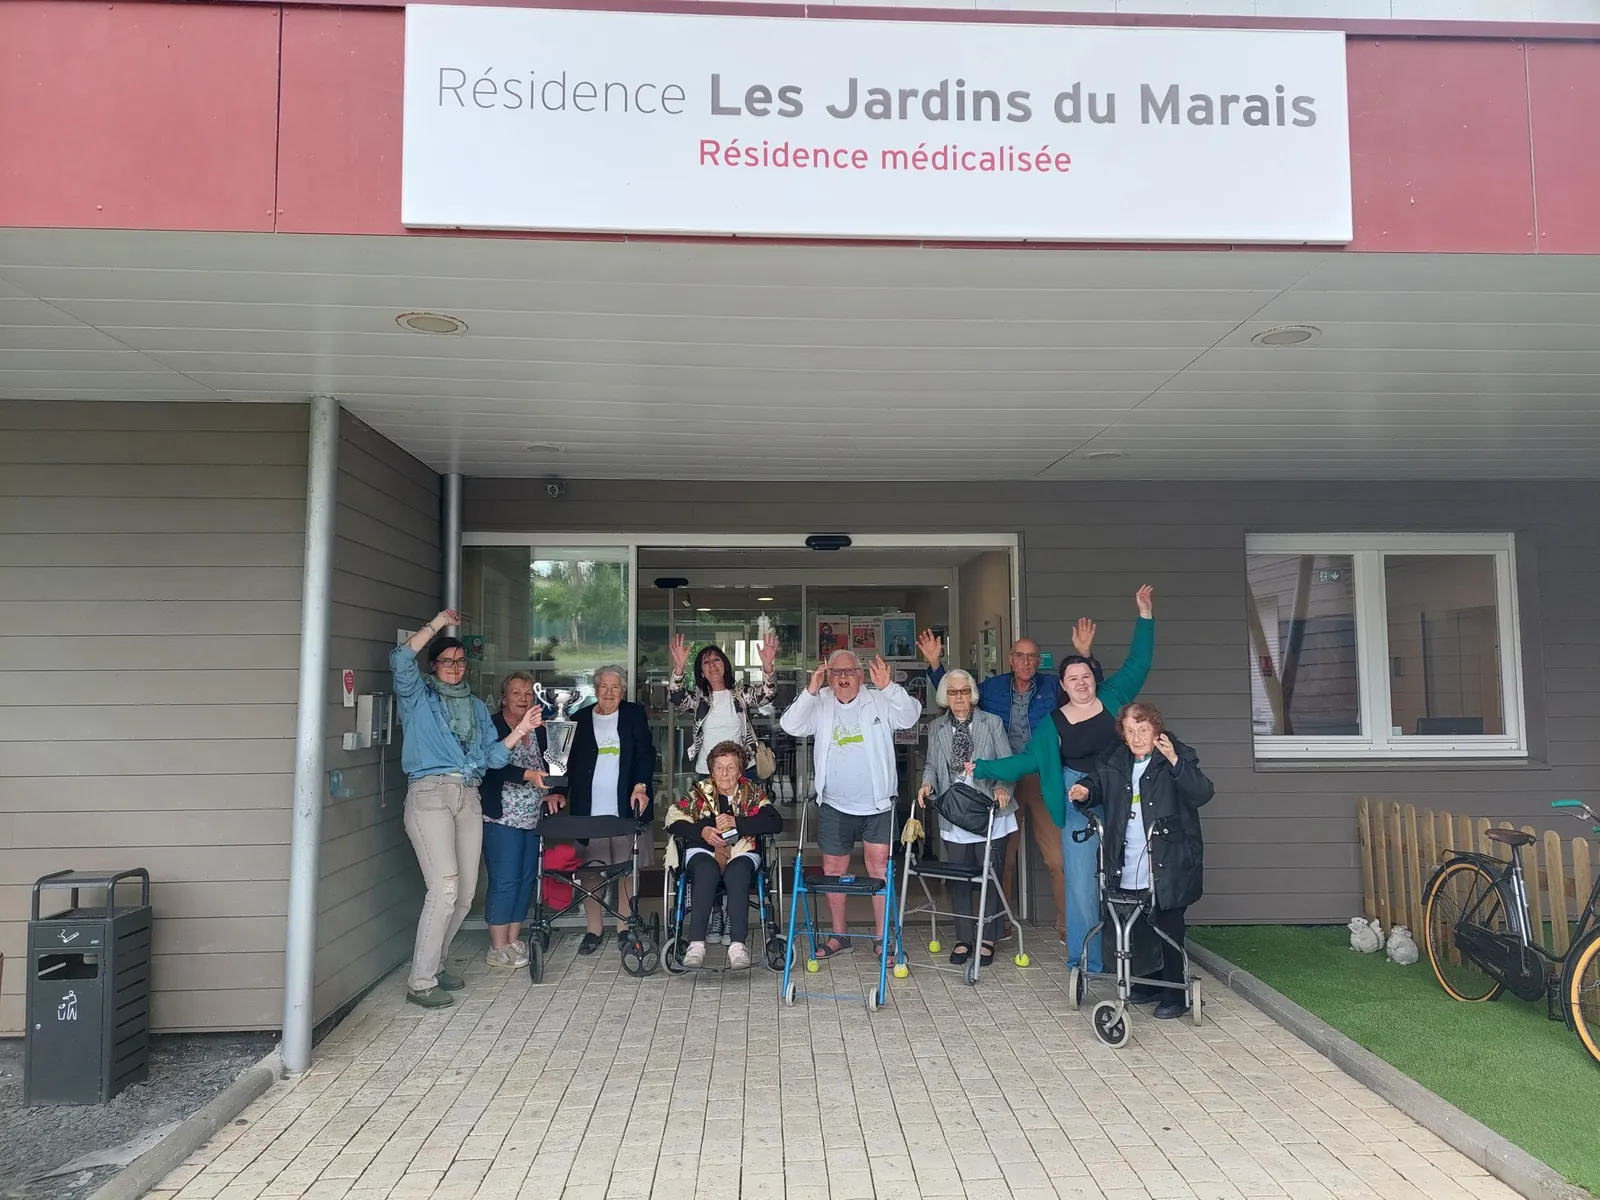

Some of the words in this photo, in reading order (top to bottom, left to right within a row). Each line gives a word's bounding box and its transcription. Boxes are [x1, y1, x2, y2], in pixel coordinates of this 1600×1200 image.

[438, 66, 686, 115] Résidence
[711, 73, 803, 119] Les
[826, 77, 1032, 123] Jardins
[1054, 80, 1117, 125] du
[1141, 83, 1317, 128] Marais
[699, 137, 870, 171] Résidence
[880, 141, 1073, 174] médicalisée
